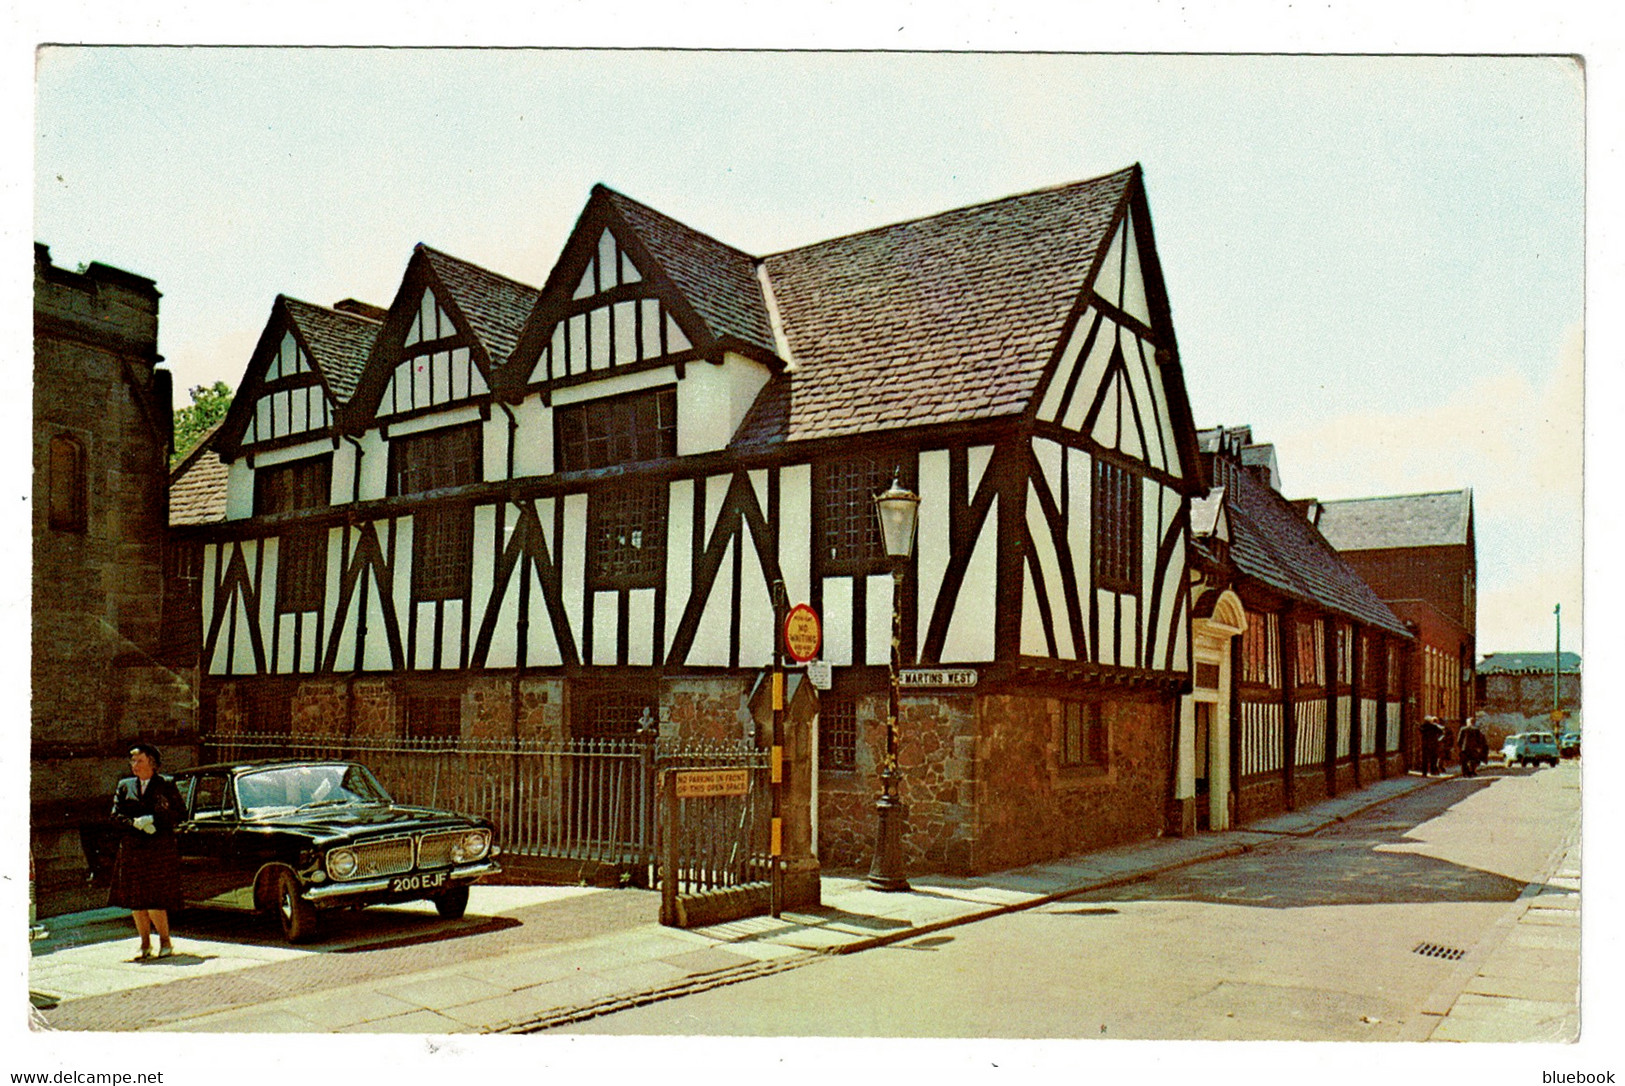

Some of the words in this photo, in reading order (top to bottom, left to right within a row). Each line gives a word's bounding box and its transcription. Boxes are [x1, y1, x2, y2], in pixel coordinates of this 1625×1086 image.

[798, 624, 808, 633] NO
[790, 634, 817, 643] WAITING
[905, 673, 944, 684] MARTINS
[948, 672, 971, 683] WEST
[677, 775, 687, 784] NO
[689, 774, 714, 783] PARKING
[716, 773, 723, 782] IN
[725, 773, 746, 782] FRONT
[678, 785, 687, 794] OF
[690, 784, 704, 793] THIS
[706, 783, 723, 792] OPEN
[726, 782, 745, 791] SPACE
[394, 876, 420, 892] 200
[422, 872, 447, 888] EJF
